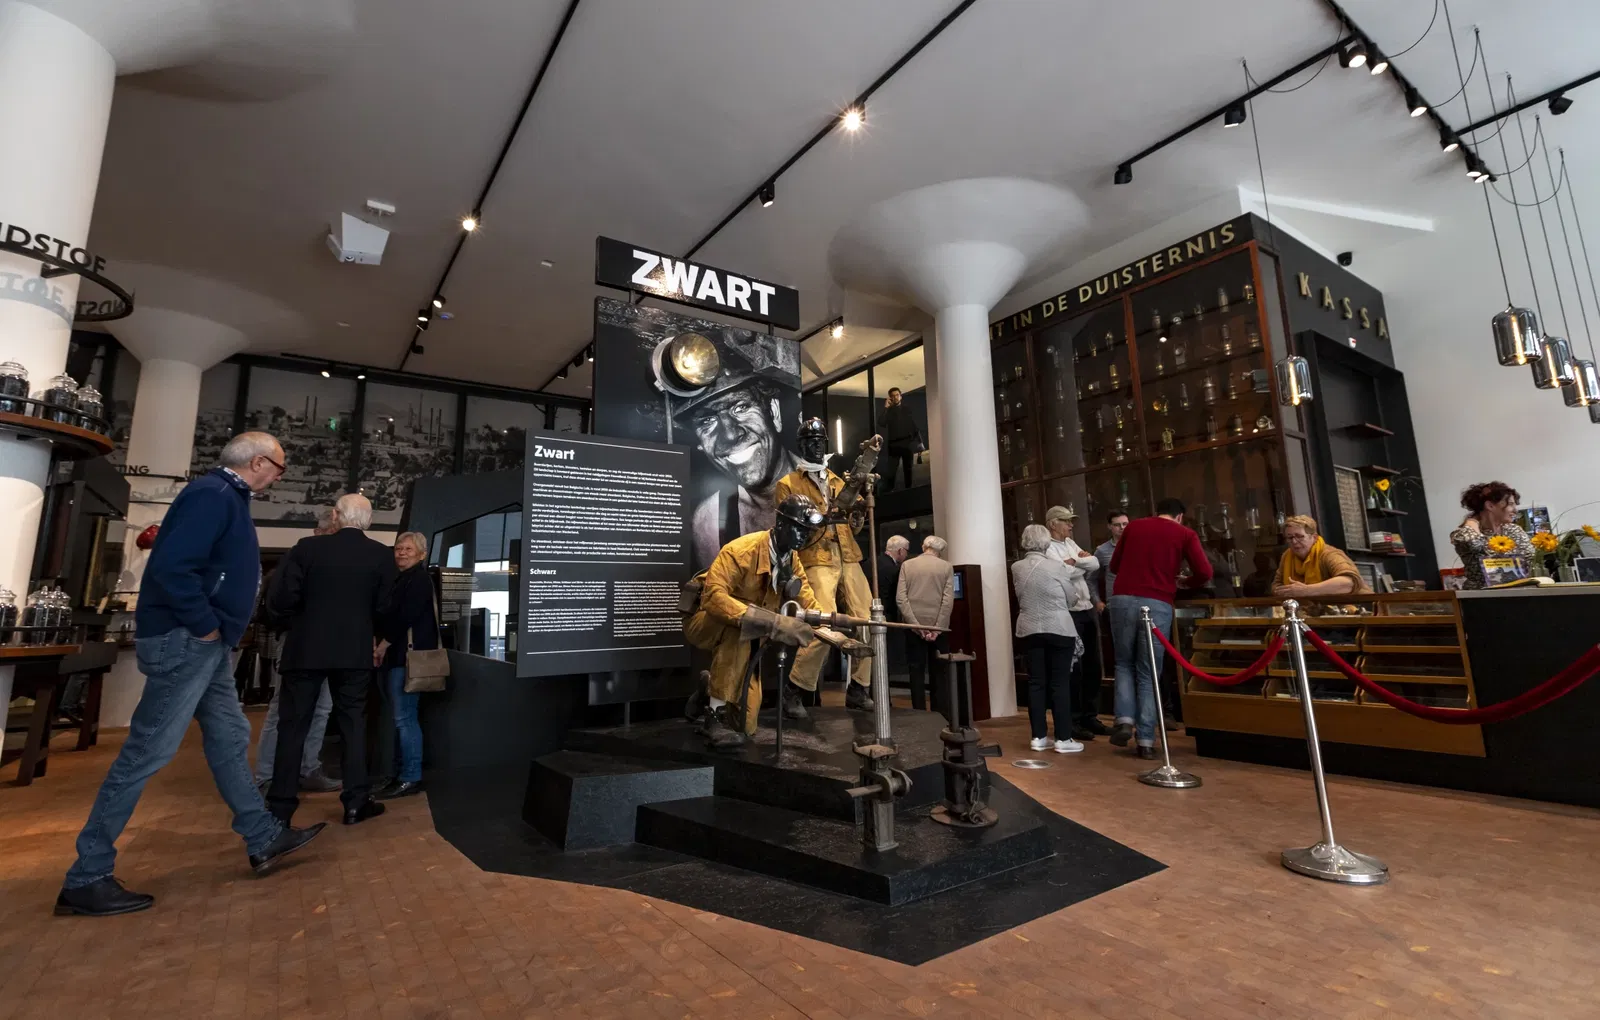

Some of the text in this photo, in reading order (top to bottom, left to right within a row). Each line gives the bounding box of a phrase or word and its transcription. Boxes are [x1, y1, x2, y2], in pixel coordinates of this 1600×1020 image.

[0, 222, 107, 274] DSTOF
[1013, 309, 1033, 331] IN
[1042, 294, 1068, 318] DE
[1079, 223, 1236, 304] DUISTERNIS
[631, 249, 776, 316] ZWART
[1298, 271, 1389, 339] KASSA
[534, 444, 575, 460] Zwart
[529, 568, 557, 576] Schwarz
